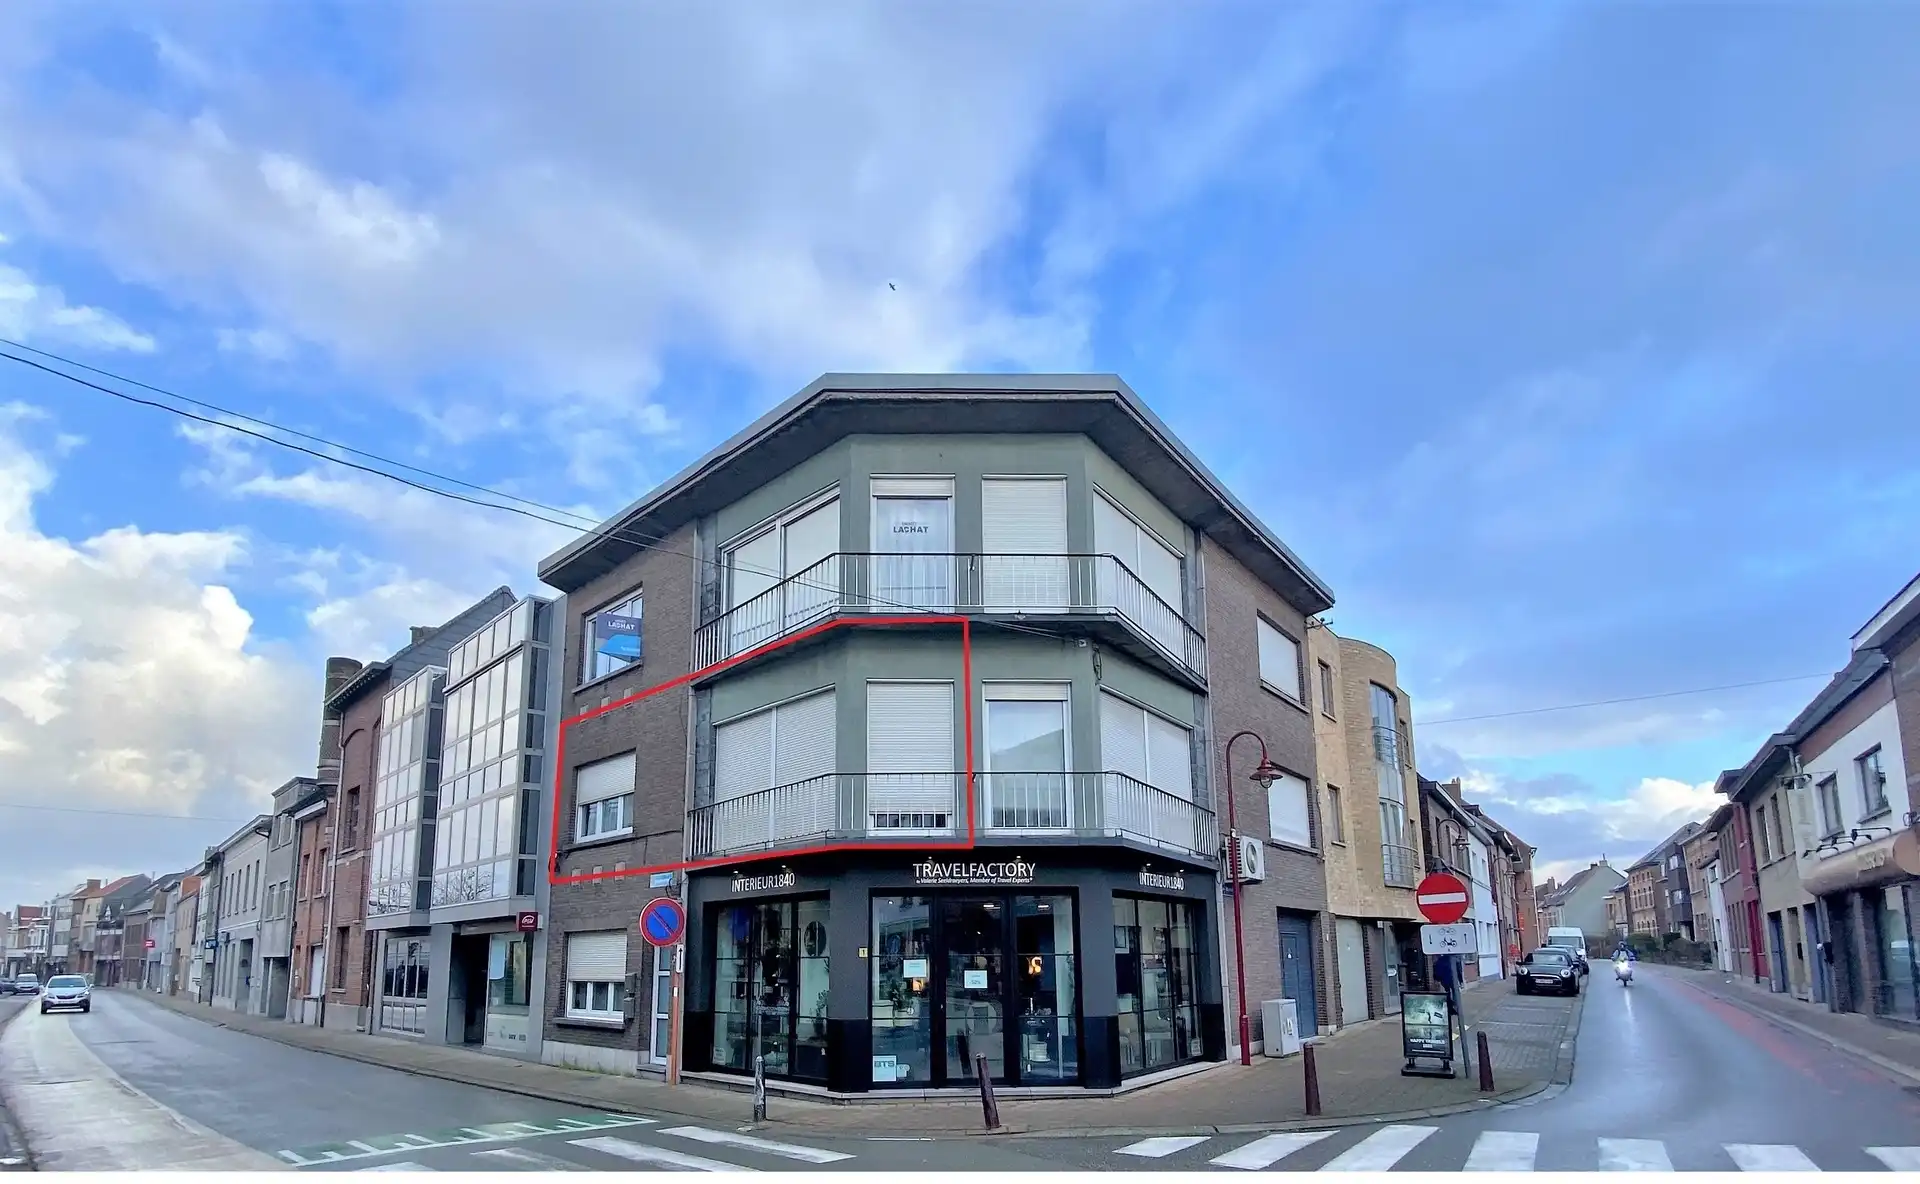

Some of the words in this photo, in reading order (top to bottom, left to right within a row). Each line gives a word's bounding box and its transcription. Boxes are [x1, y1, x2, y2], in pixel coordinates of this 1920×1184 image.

[608, 620, 635, 630] LACHAT
[912, 863, 1036, 877] TRAVELFACTORY
[731, 873, 795, 892] INTERIEUR1840
[1139, 872, 1184, 890] INTERIEUR1840
